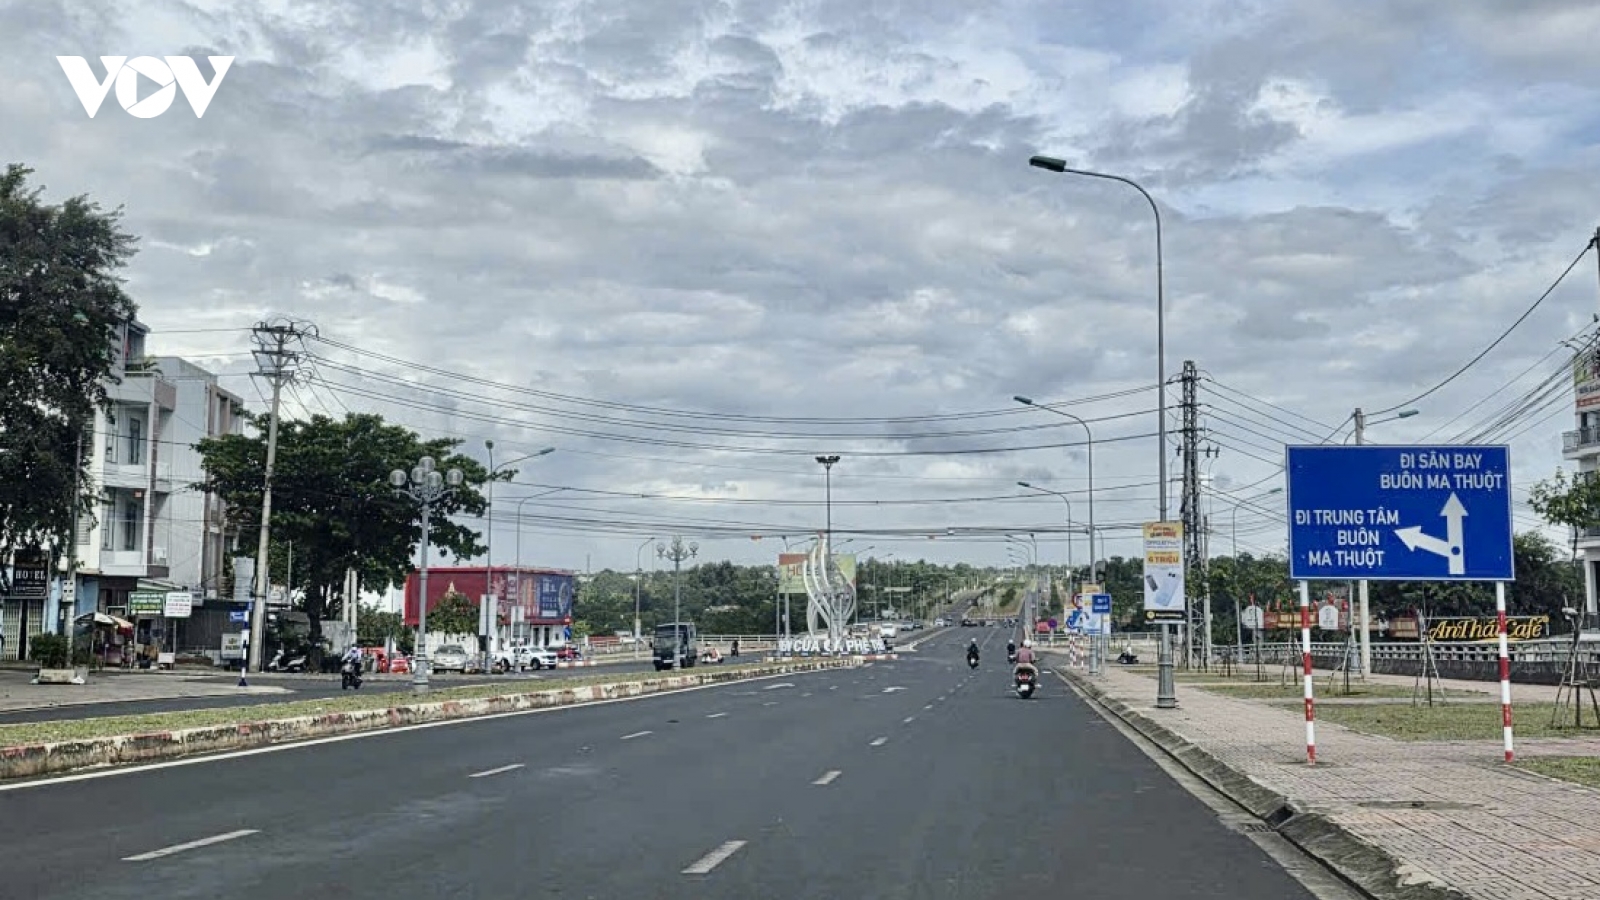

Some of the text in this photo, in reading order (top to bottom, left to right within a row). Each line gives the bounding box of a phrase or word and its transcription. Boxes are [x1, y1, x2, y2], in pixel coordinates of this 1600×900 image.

[1400, 450, 1482, 469] ĐI SÂN BAY
[1380, 470, 1503, 492] BUÔN MA THUỘT
[1295, 505, 1399, 525] ĐI TRUNG TÂM
[1337, 528, 1380, 546] BUÔN
[1308, 550, 1384, 569] MA THUỘT
